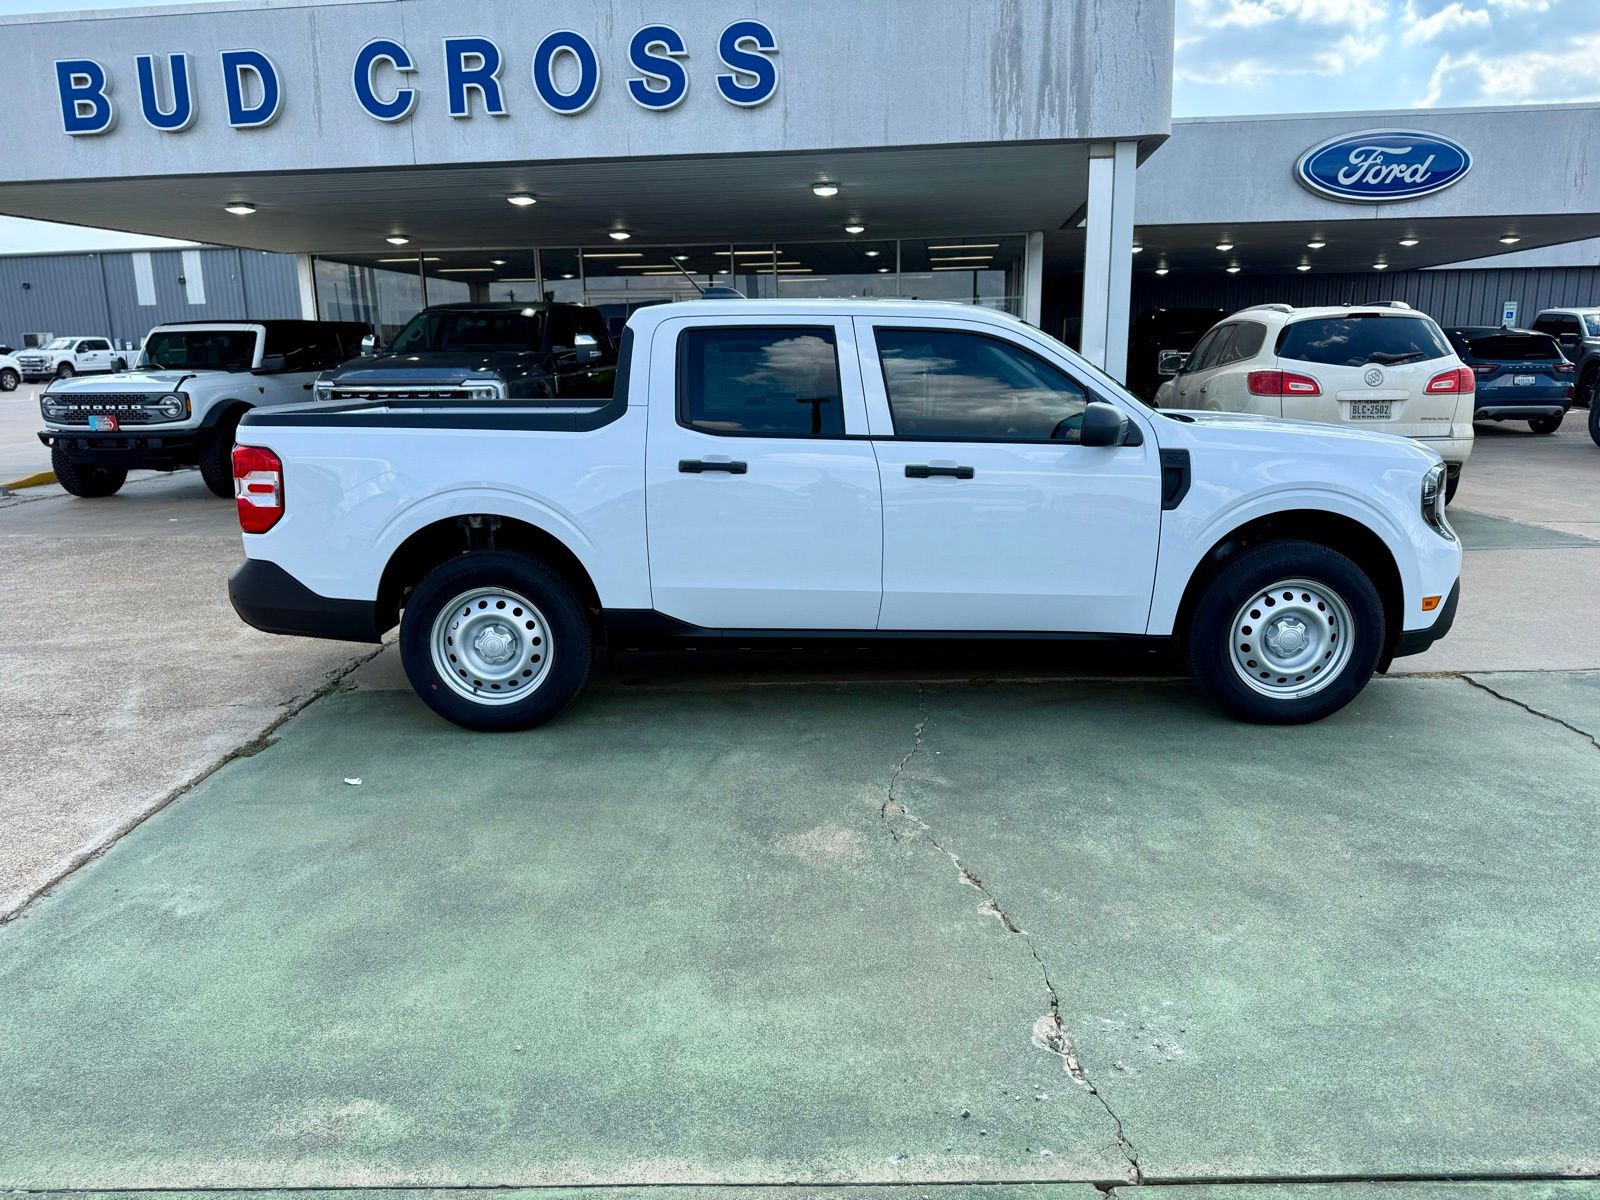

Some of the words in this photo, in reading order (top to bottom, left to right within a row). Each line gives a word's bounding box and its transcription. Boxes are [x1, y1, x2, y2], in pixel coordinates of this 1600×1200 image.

[54, 49, 283, 135] BUD
[352, 19, 779, 121] CROSS
[1337, 146, 1436, 186] Ford
